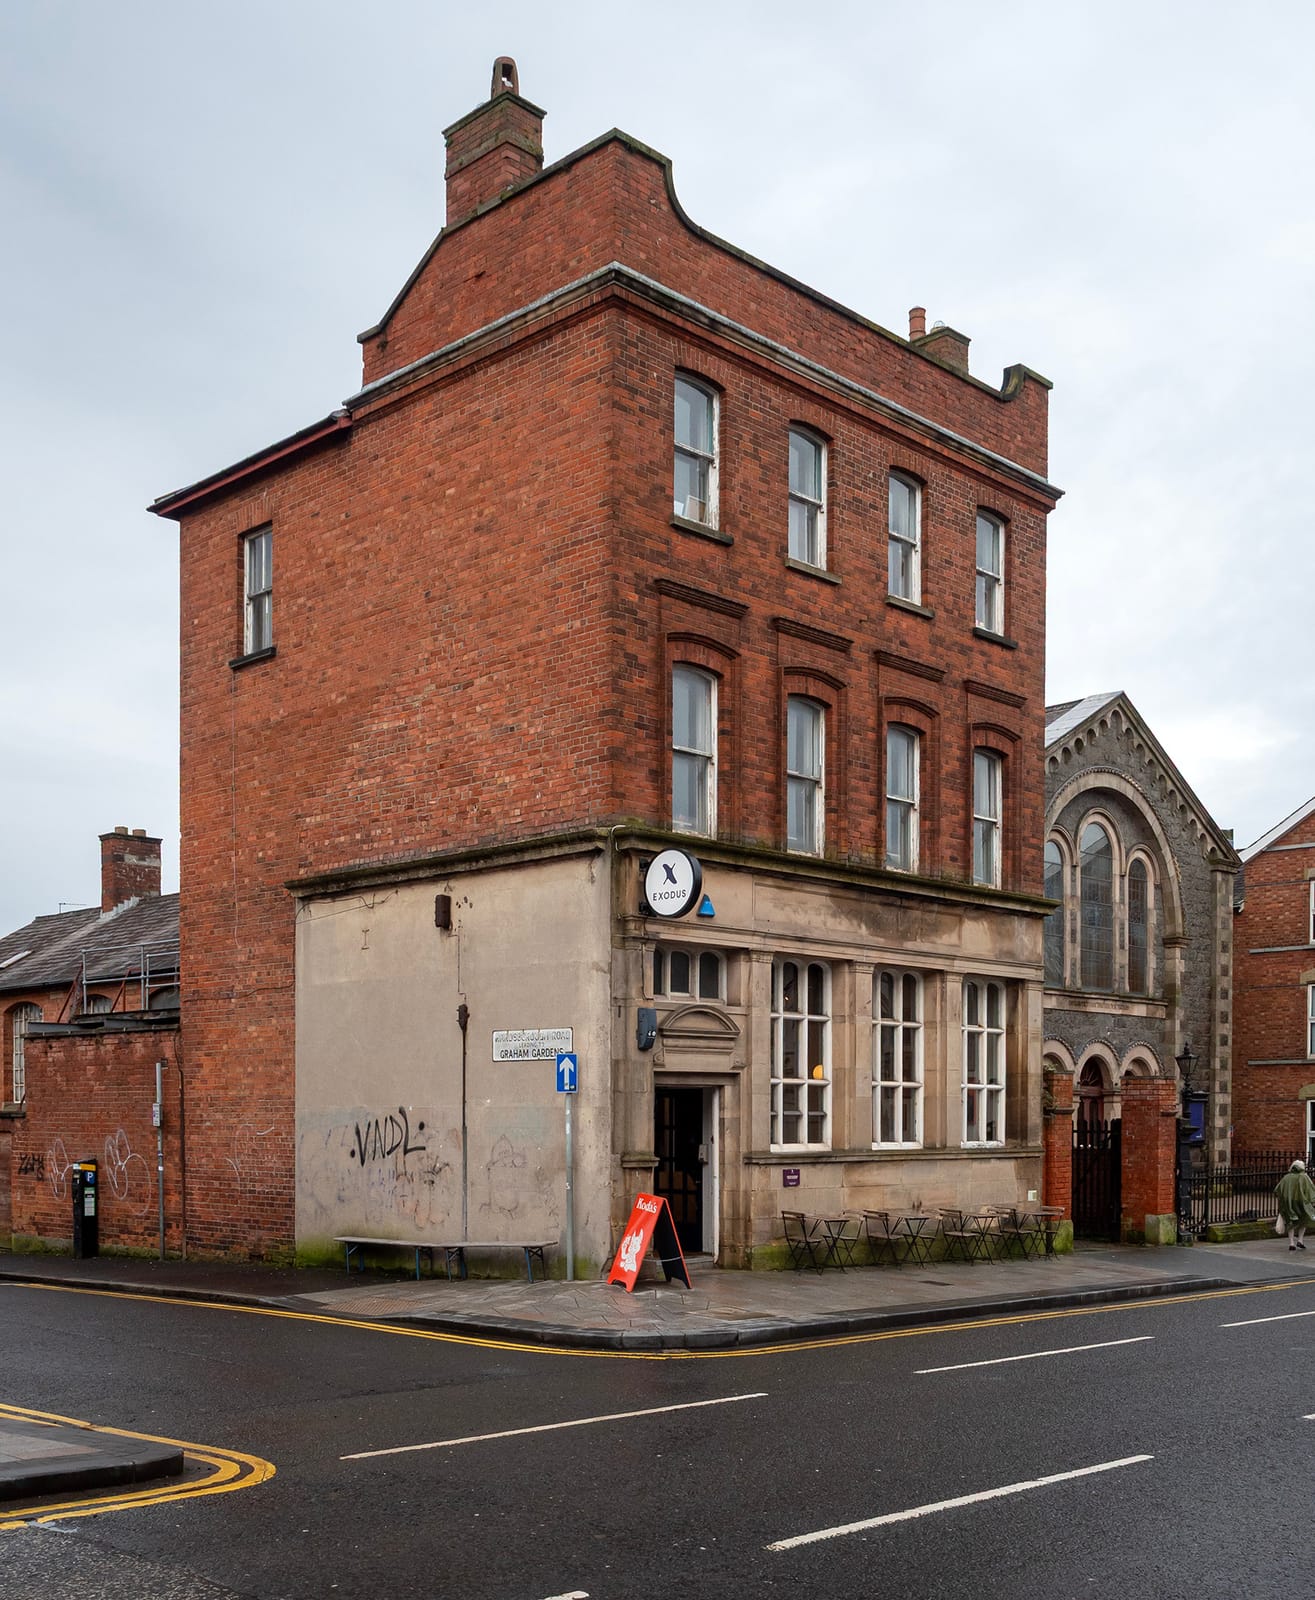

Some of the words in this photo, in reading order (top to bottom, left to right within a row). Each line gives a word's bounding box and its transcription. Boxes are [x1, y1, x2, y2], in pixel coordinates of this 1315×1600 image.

[653, 889, 686, 901] EXODUS
[551, 1030, 569, 1041] ROAD
[500, 1049, 529, 1059] GRAHAM
[532, 1048, 564, 1058] GARDENS
[87, 1171, 93, 1182] P
[636, 1197, 657, 1214] Koda's
